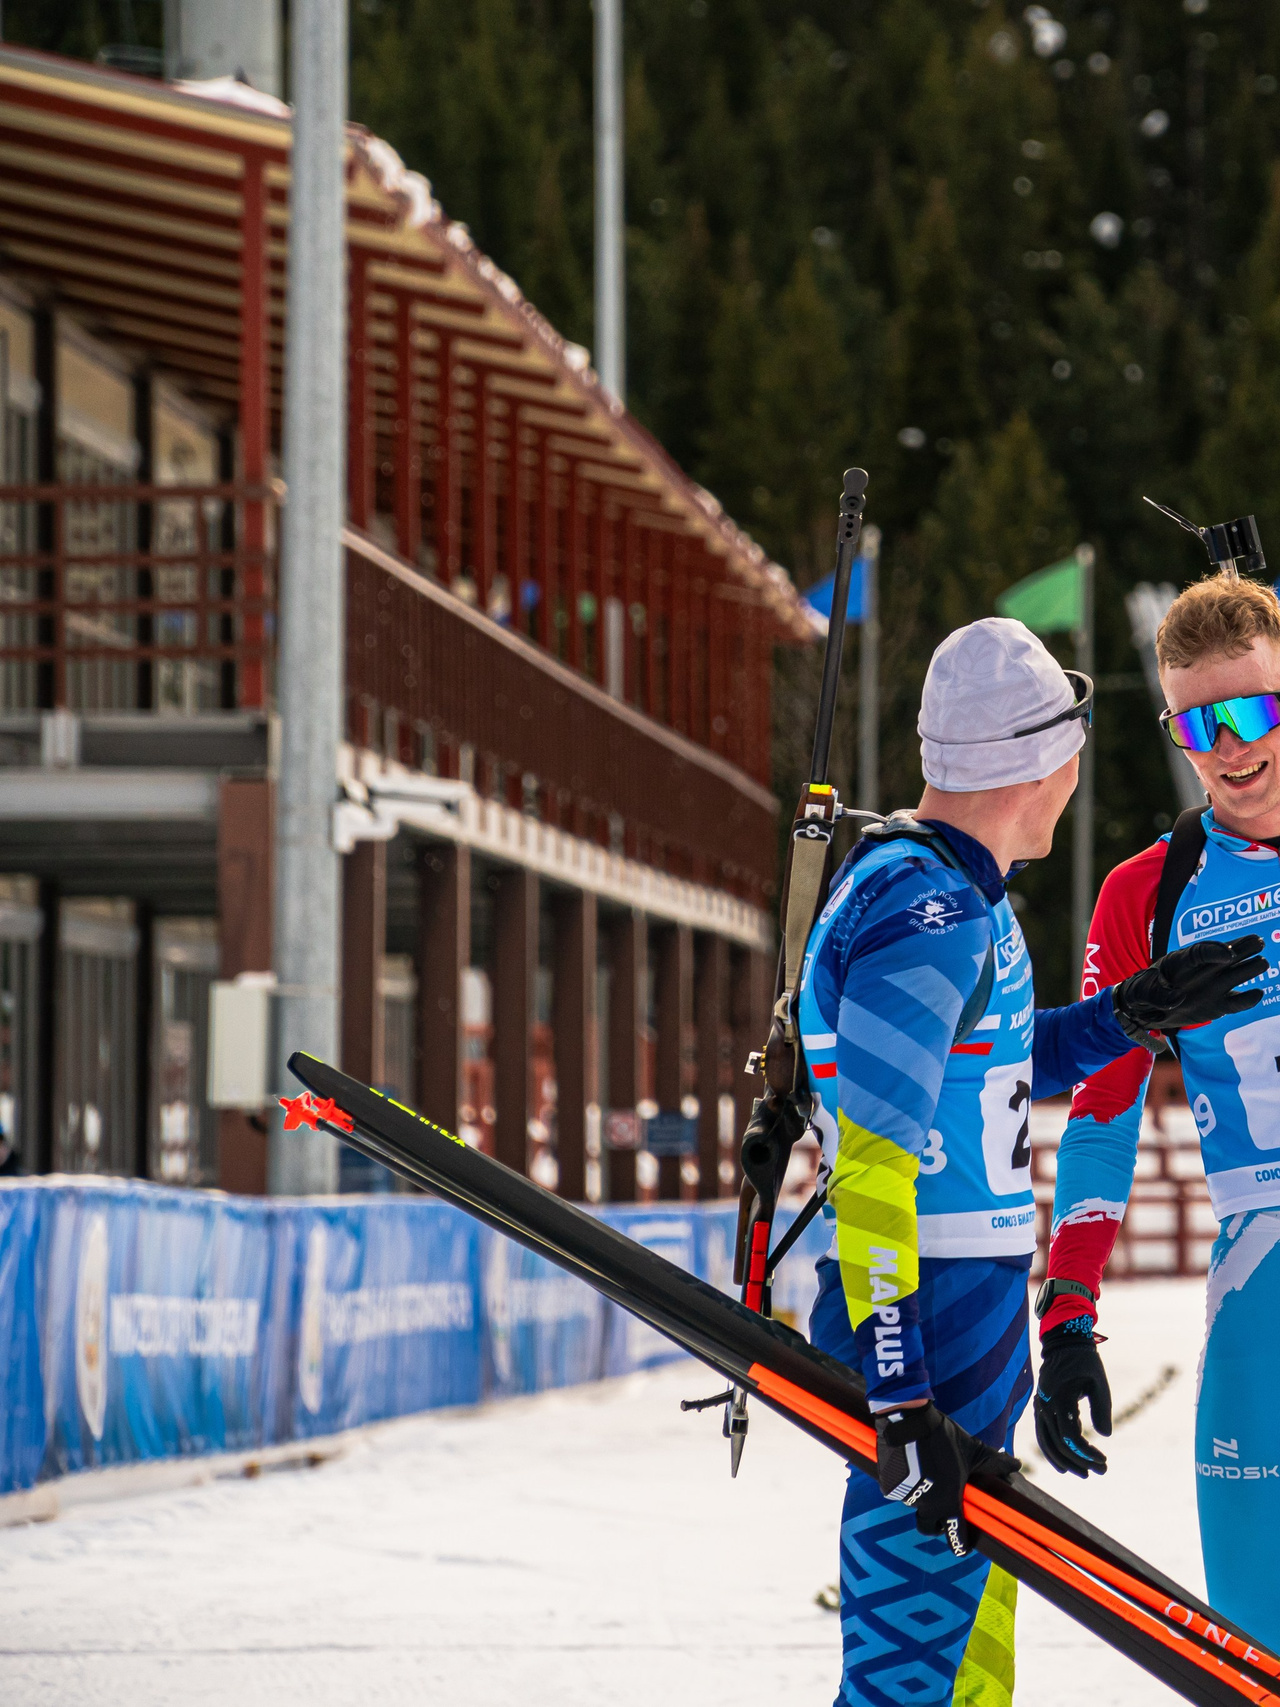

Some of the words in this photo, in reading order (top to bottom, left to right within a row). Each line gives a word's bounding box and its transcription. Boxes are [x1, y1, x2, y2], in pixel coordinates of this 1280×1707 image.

[938, 890, 959, 909] ЛОСЬ
[1194, 924, 1226, 940] АВТОНОМНОЕ
[991, 1214, 1018, 1229] СОЮЗ
[868, 1245, 905, 1378] MAPLUS
[903, 1478, 934, 1507] Roe
[946, 1517, 967, 1558] Roeckl
